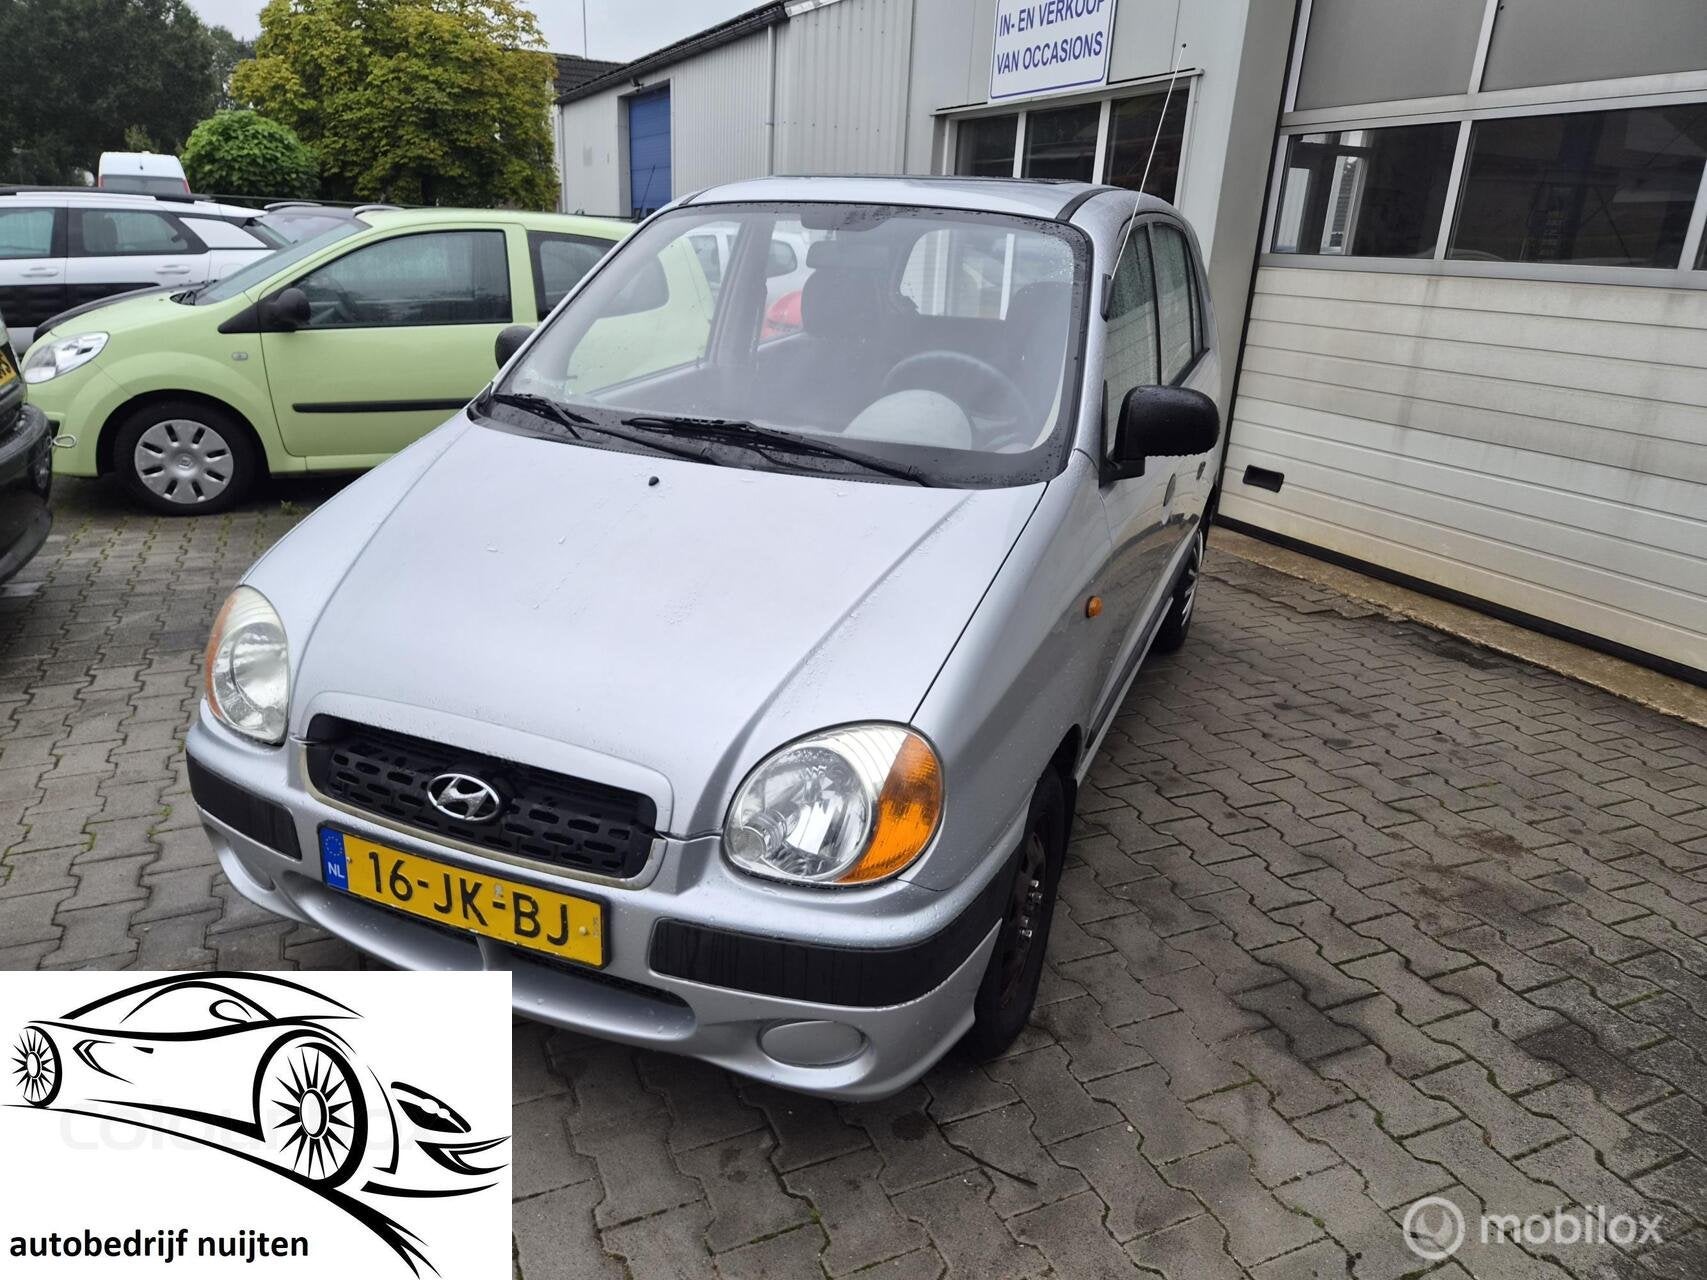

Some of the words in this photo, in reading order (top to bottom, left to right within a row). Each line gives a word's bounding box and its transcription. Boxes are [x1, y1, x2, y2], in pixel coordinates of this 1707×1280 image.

[999, 14, 1016, 37] IN-
[1018, 6, 1036, 32] EN
[996, 50, 1020, 75] VAN
[1022, 31, 1104, 71] OCCASIONS
[327, 861, 345, 879] NL
[368, 851, 570, 946] 16-JK-BJ
